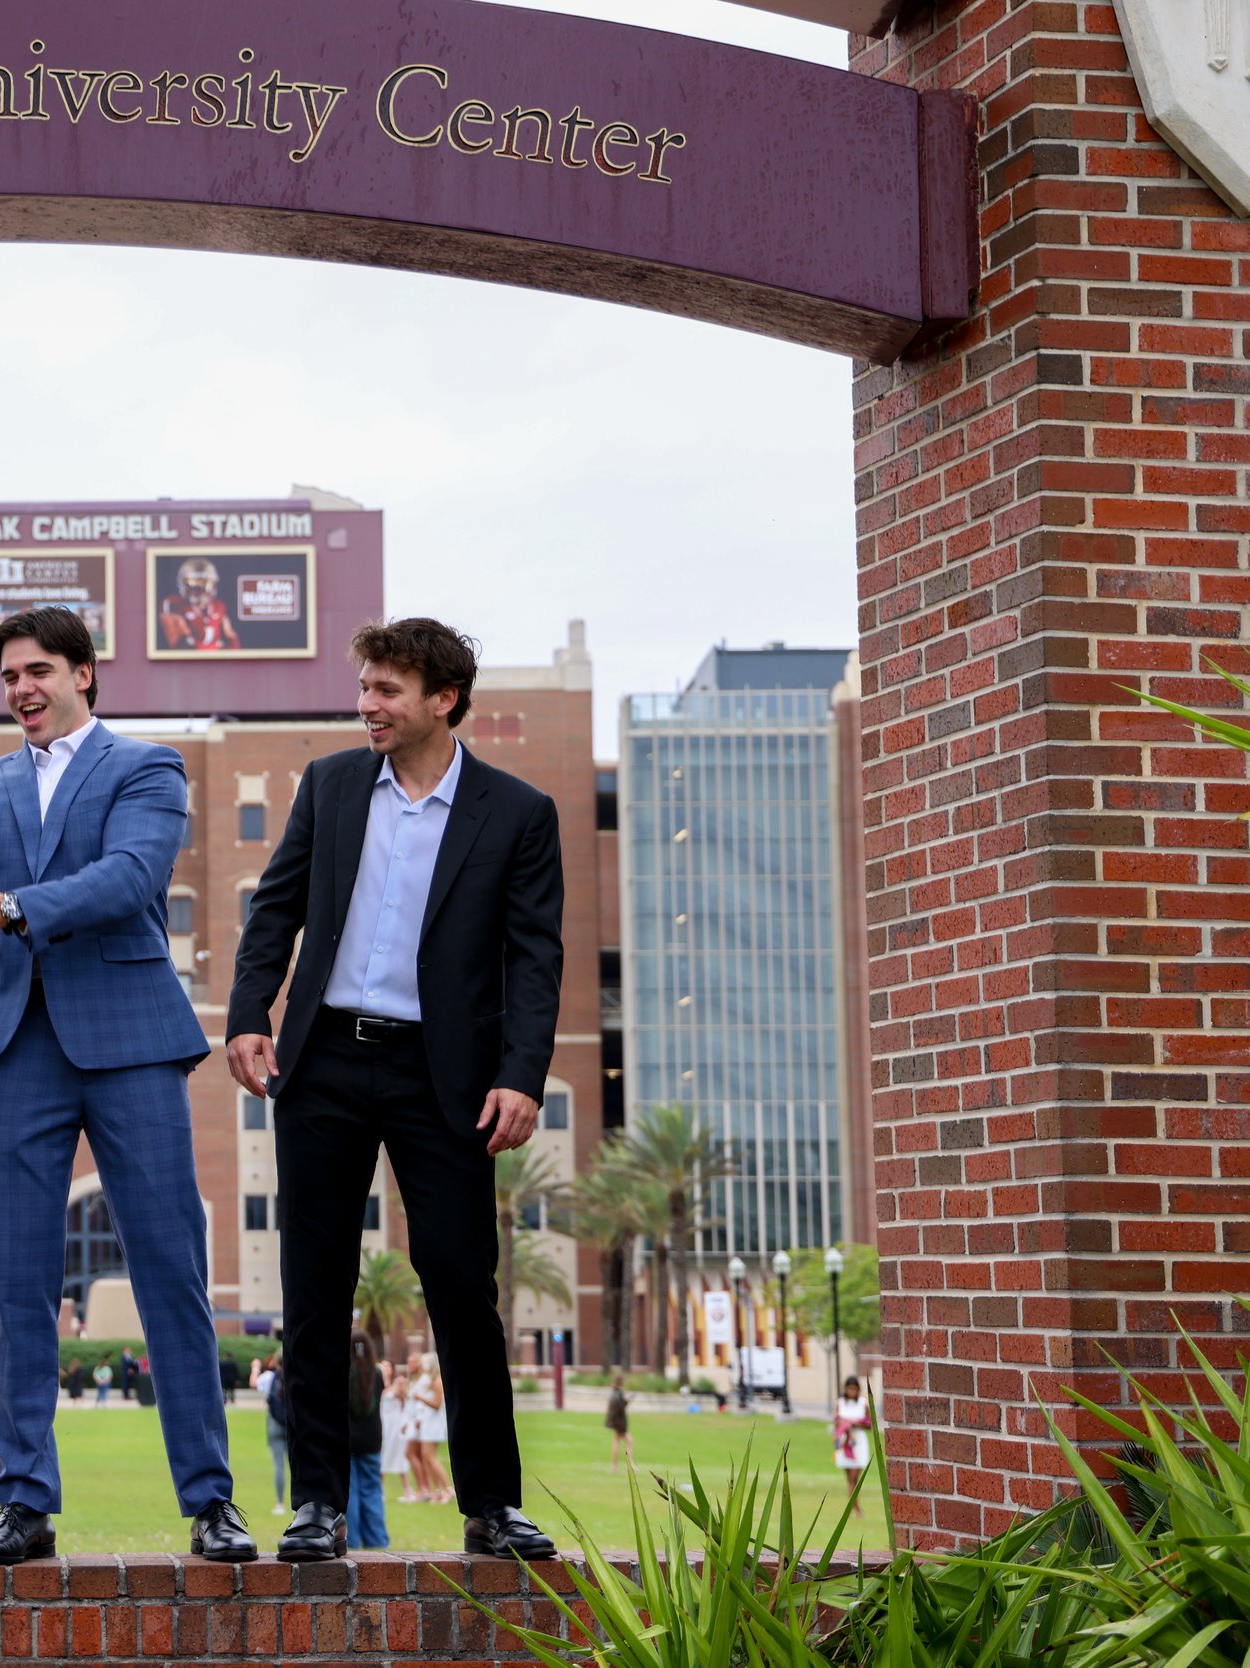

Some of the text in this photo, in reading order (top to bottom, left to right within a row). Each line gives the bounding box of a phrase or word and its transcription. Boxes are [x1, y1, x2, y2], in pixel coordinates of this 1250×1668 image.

[375, 63, 686, 184] Center
[32, 513, 179, 541] CAMPBELL
[190, 512, 313, 539] STADIUM
